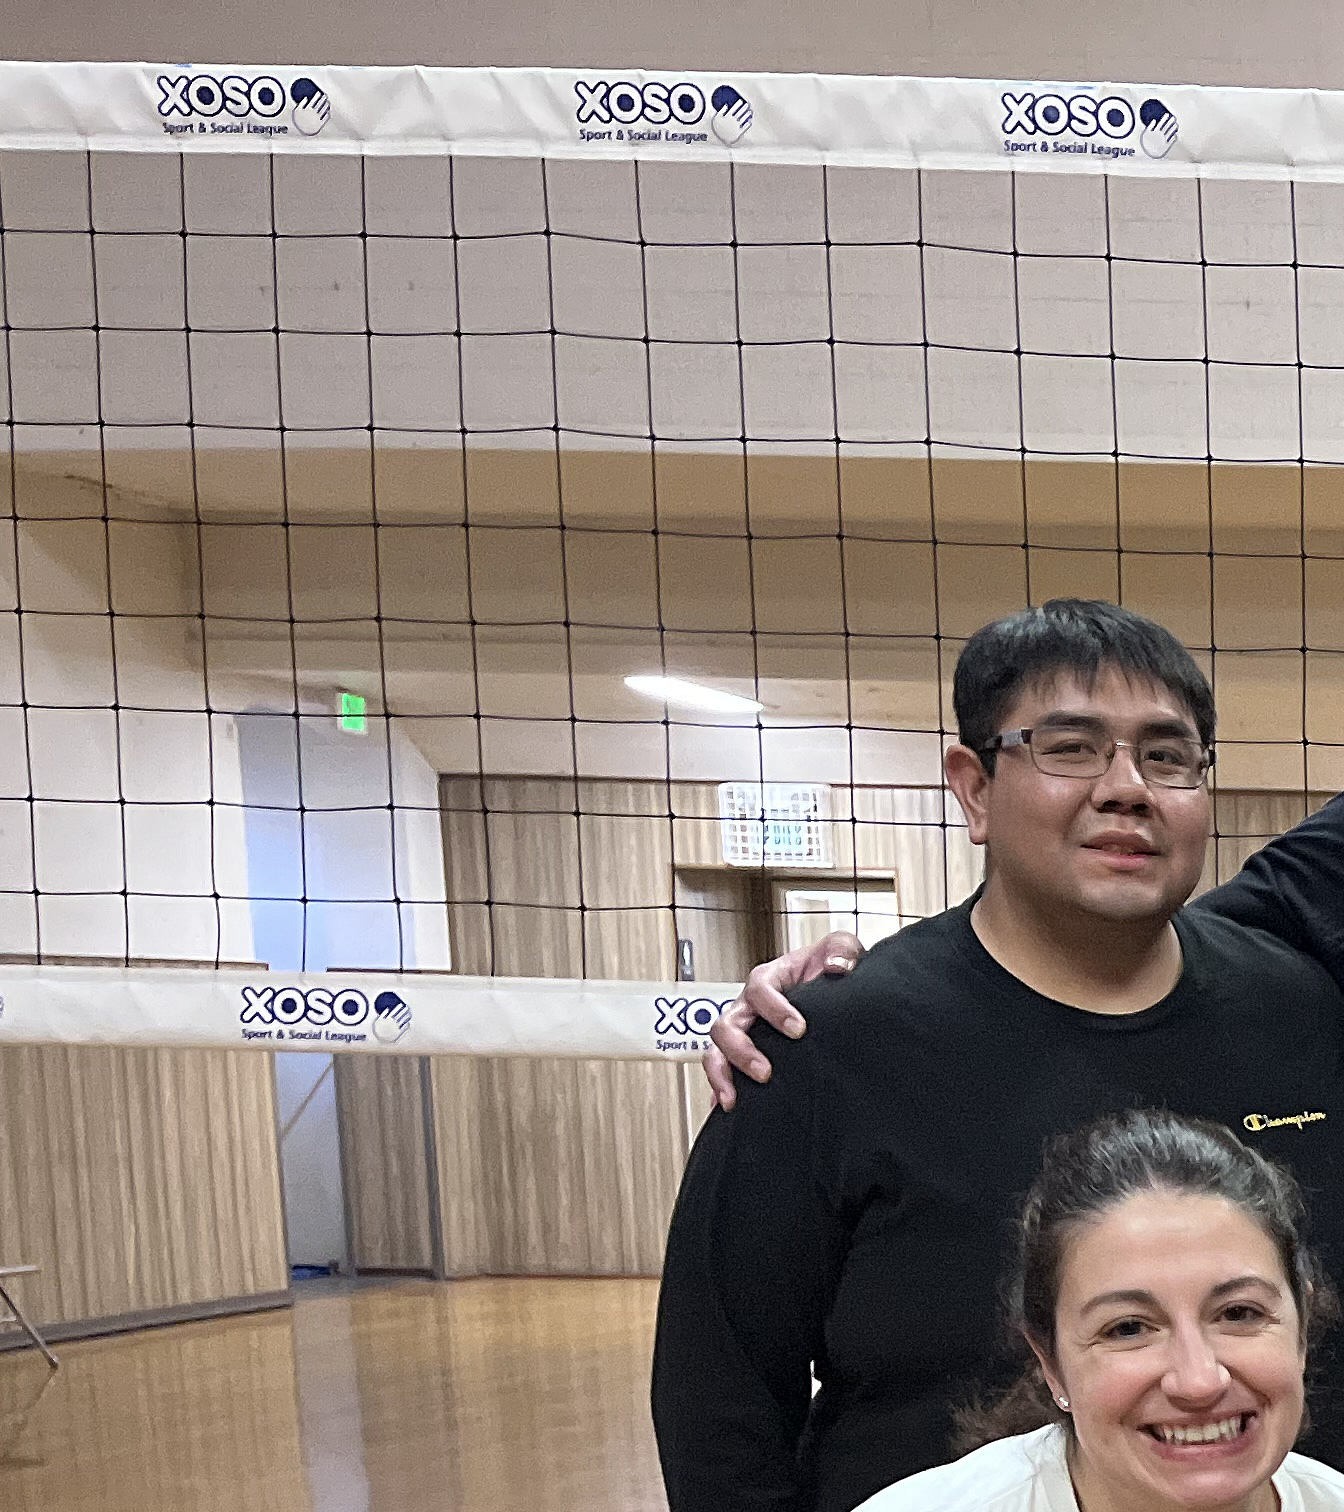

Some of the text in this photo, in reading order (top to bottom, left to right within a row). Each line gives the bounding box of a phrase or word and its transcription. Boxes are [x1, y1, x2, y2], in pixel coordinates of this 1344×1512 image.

[157, 75, 286, 118] XOSO
[575, 80, 707, 125] XOSO
[1001, 92, 1136, 139] XOSO
[162, 122, 195, 135] Sport
[210, 122, 243, 134] Social
[247, 122, 289, 138] League
[579, 129, 613, 142] Sport
[628, 129, 661, 141] Social
[665, 129, 709, 145] League
[1003, 140, 1037, 152] Sport
[1052, 141, 1088, 154] Social
[1091, 143, 1136, 159] League
[240, 986, 370, 1026] XOSO
[241, 1029, 272, 1041] Sport
[289, 1029, 322, 1041] Social
[325, 1029, 367, 1043] League
[656, 1040, 687, 1051] Sport
[1243, 1111, 1327, 1131] Champion
